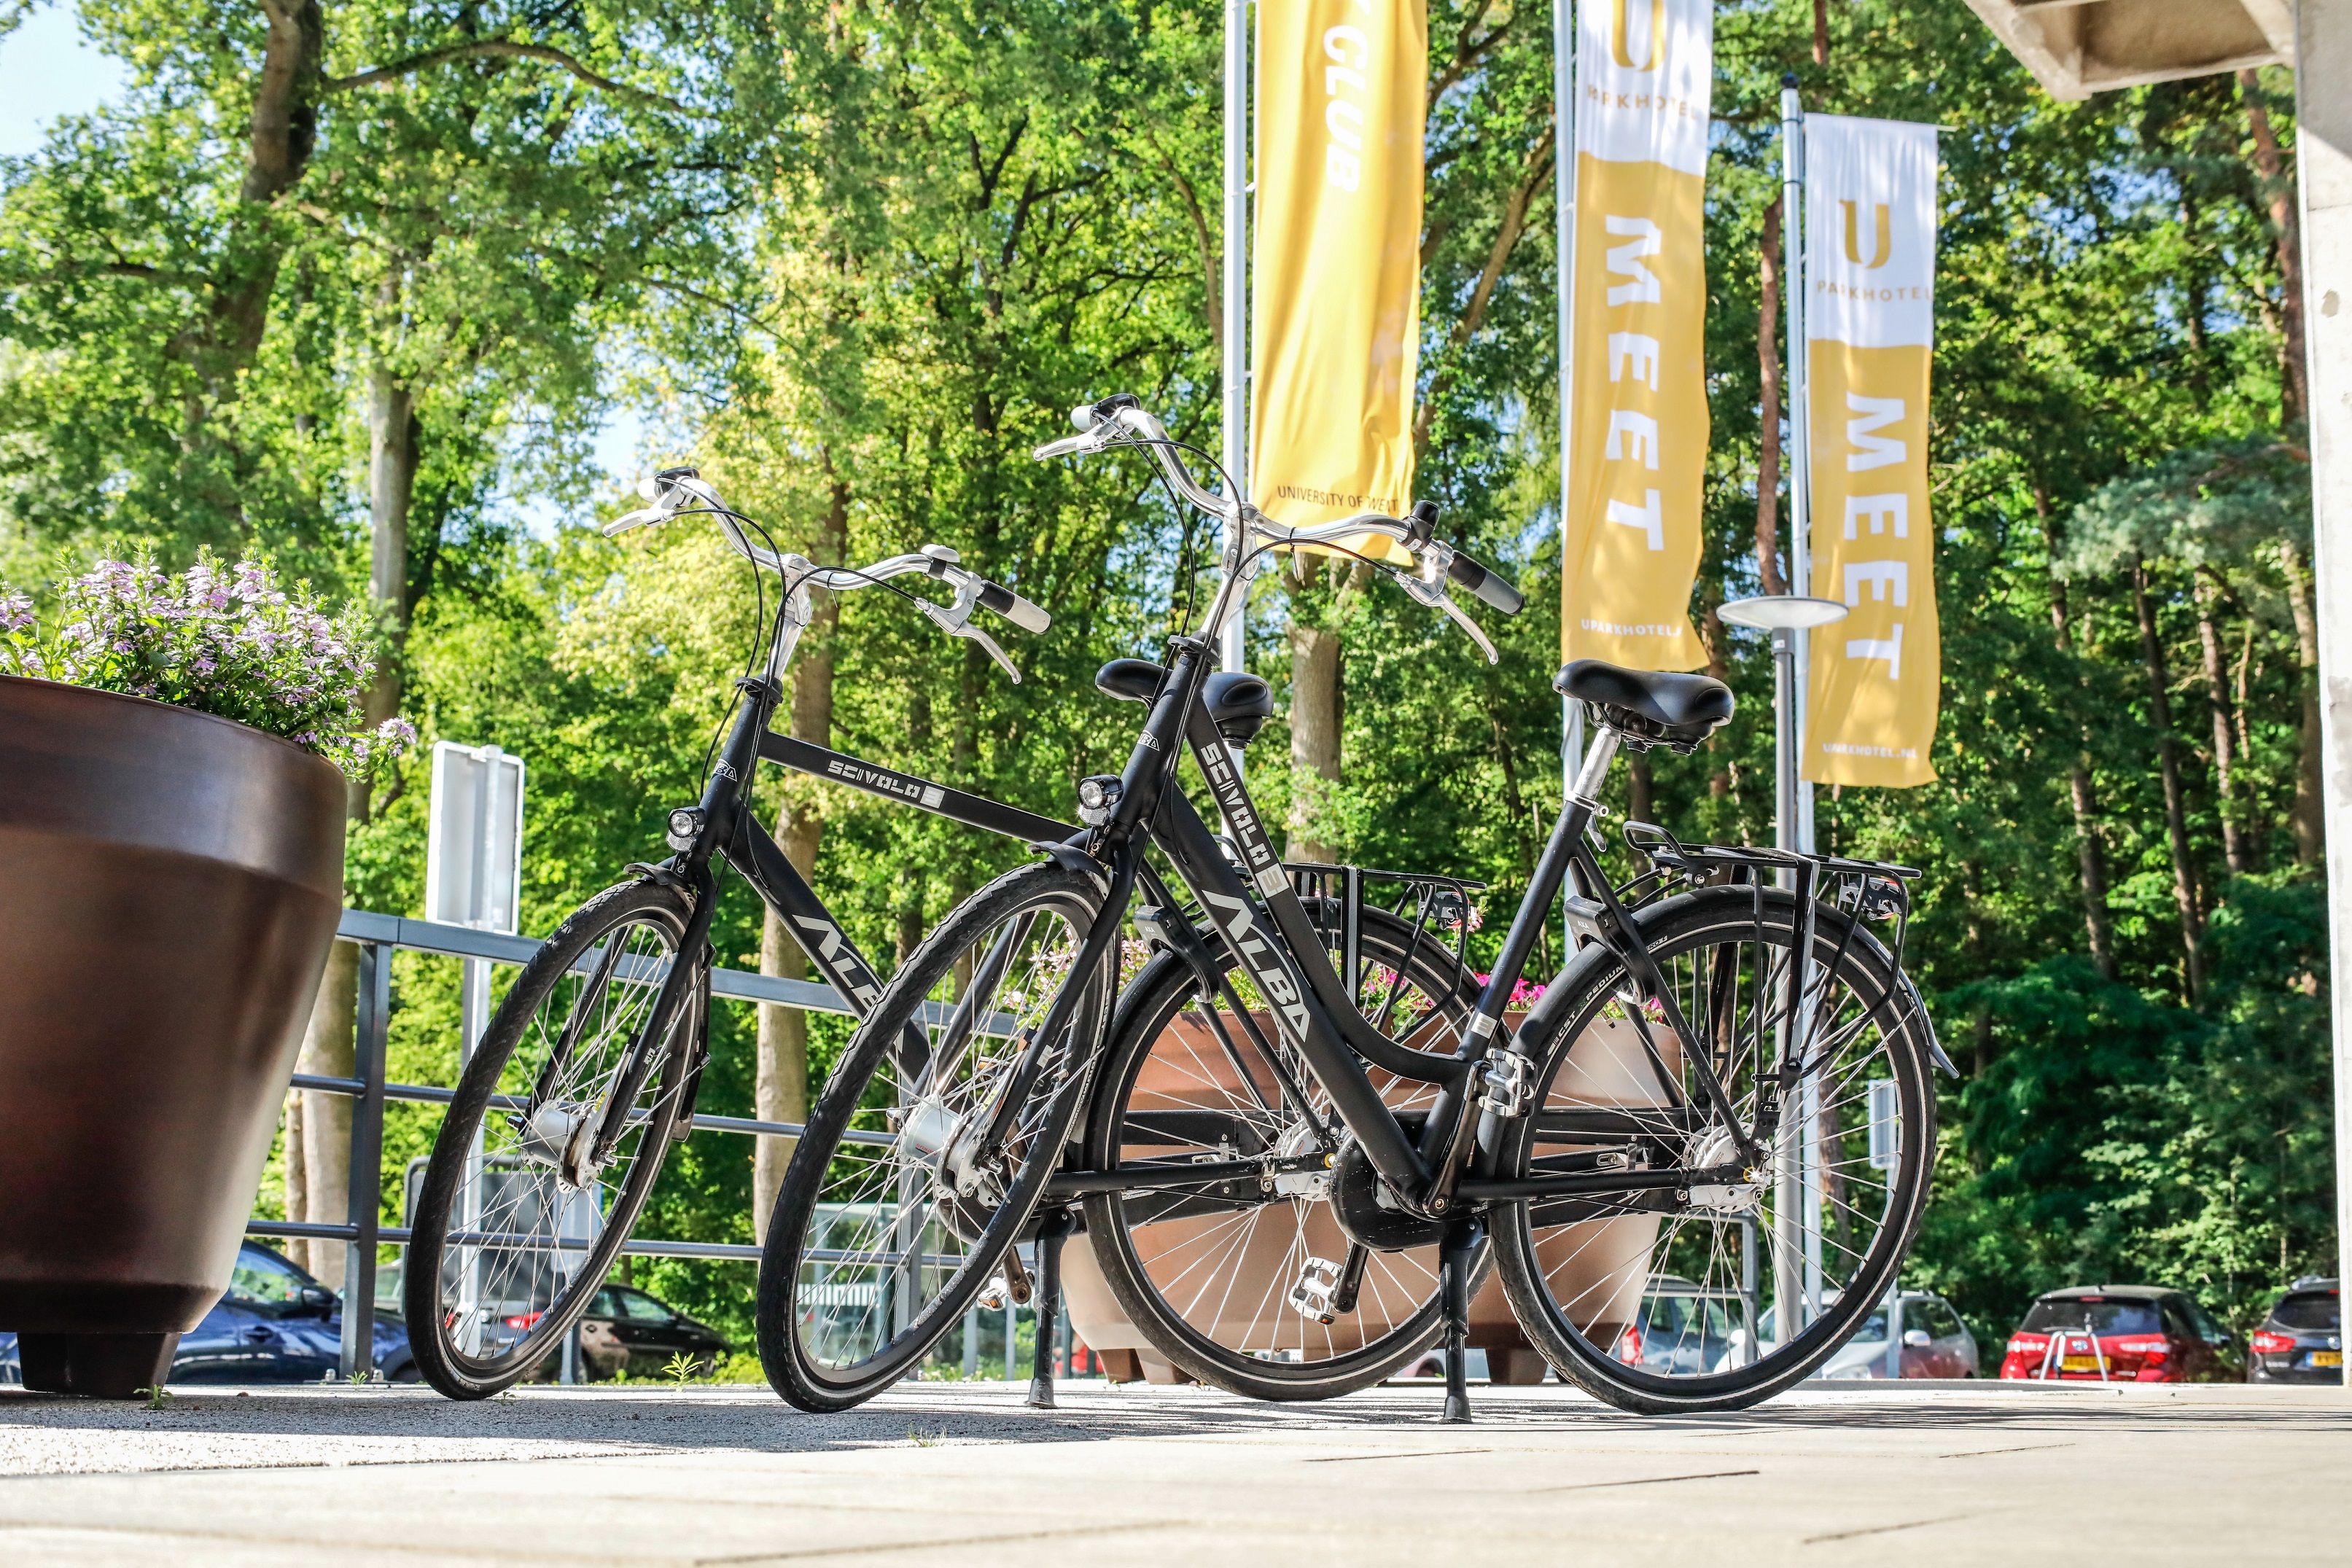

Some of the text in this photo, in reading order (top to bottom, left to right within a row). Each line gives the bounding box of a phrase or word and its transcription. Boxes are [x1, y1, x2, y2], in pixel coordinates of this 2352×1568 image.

[1323, 24, 1369, 193] CLUB
[1838, 199, 1891, 269] U
[1605, 214, 1664, 551] MEET
[1277, 485, 1344, 507] UNIVERSITY
[1348, 495, 1363, 507] OF
[1843, 391, 1909, 680] MEET
[828, 760, 922, 799] SCIVOLO
[1200, 742, 1271, 866] SCIVOLO
[792, 914, 885, 1013] ALB
[1202, 889, 1311, 1043] ALBA
[1558, 1010, 1576, 1037] CST
